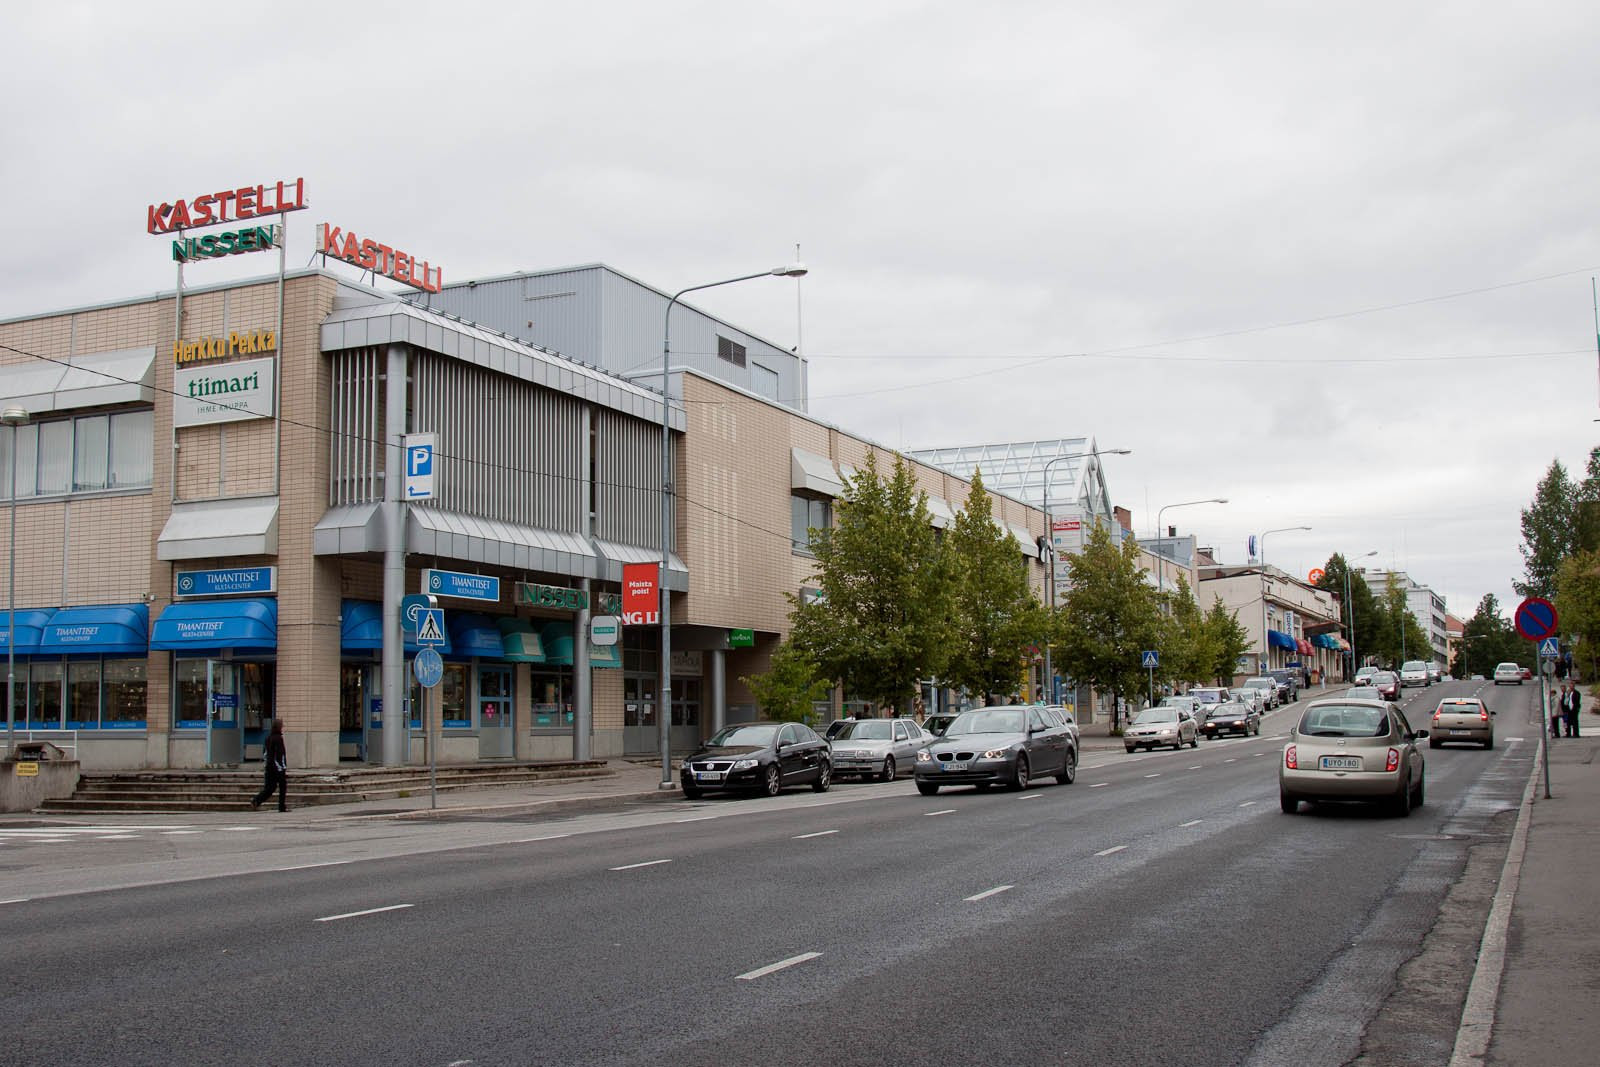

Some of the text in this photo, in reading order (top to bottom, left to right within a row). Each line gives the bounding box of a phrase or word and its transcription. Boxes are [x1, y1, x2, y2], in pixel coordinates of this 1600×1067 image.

[147, 177, 304, 233] KASTELLI
[172, 224, 274, 261] NISSEN
[323, 222, 442, 294] KASTELLI
[173, 329, 276, 363] Herkku Pekka
[188, 371, 259, 397] tiimari
[197, 404, 216, 414] IHME
[412, 448, 429, 475] P
[207, 572, 260, 584] TIMANTTISET
[451, 576, 491, 590] TIMANTTISET
[523, 584, 589, 609] NISSEN
[56, 627, 99, 636] TIMANTTISET
[177, 621, 224, 631] TIMANTTISET
